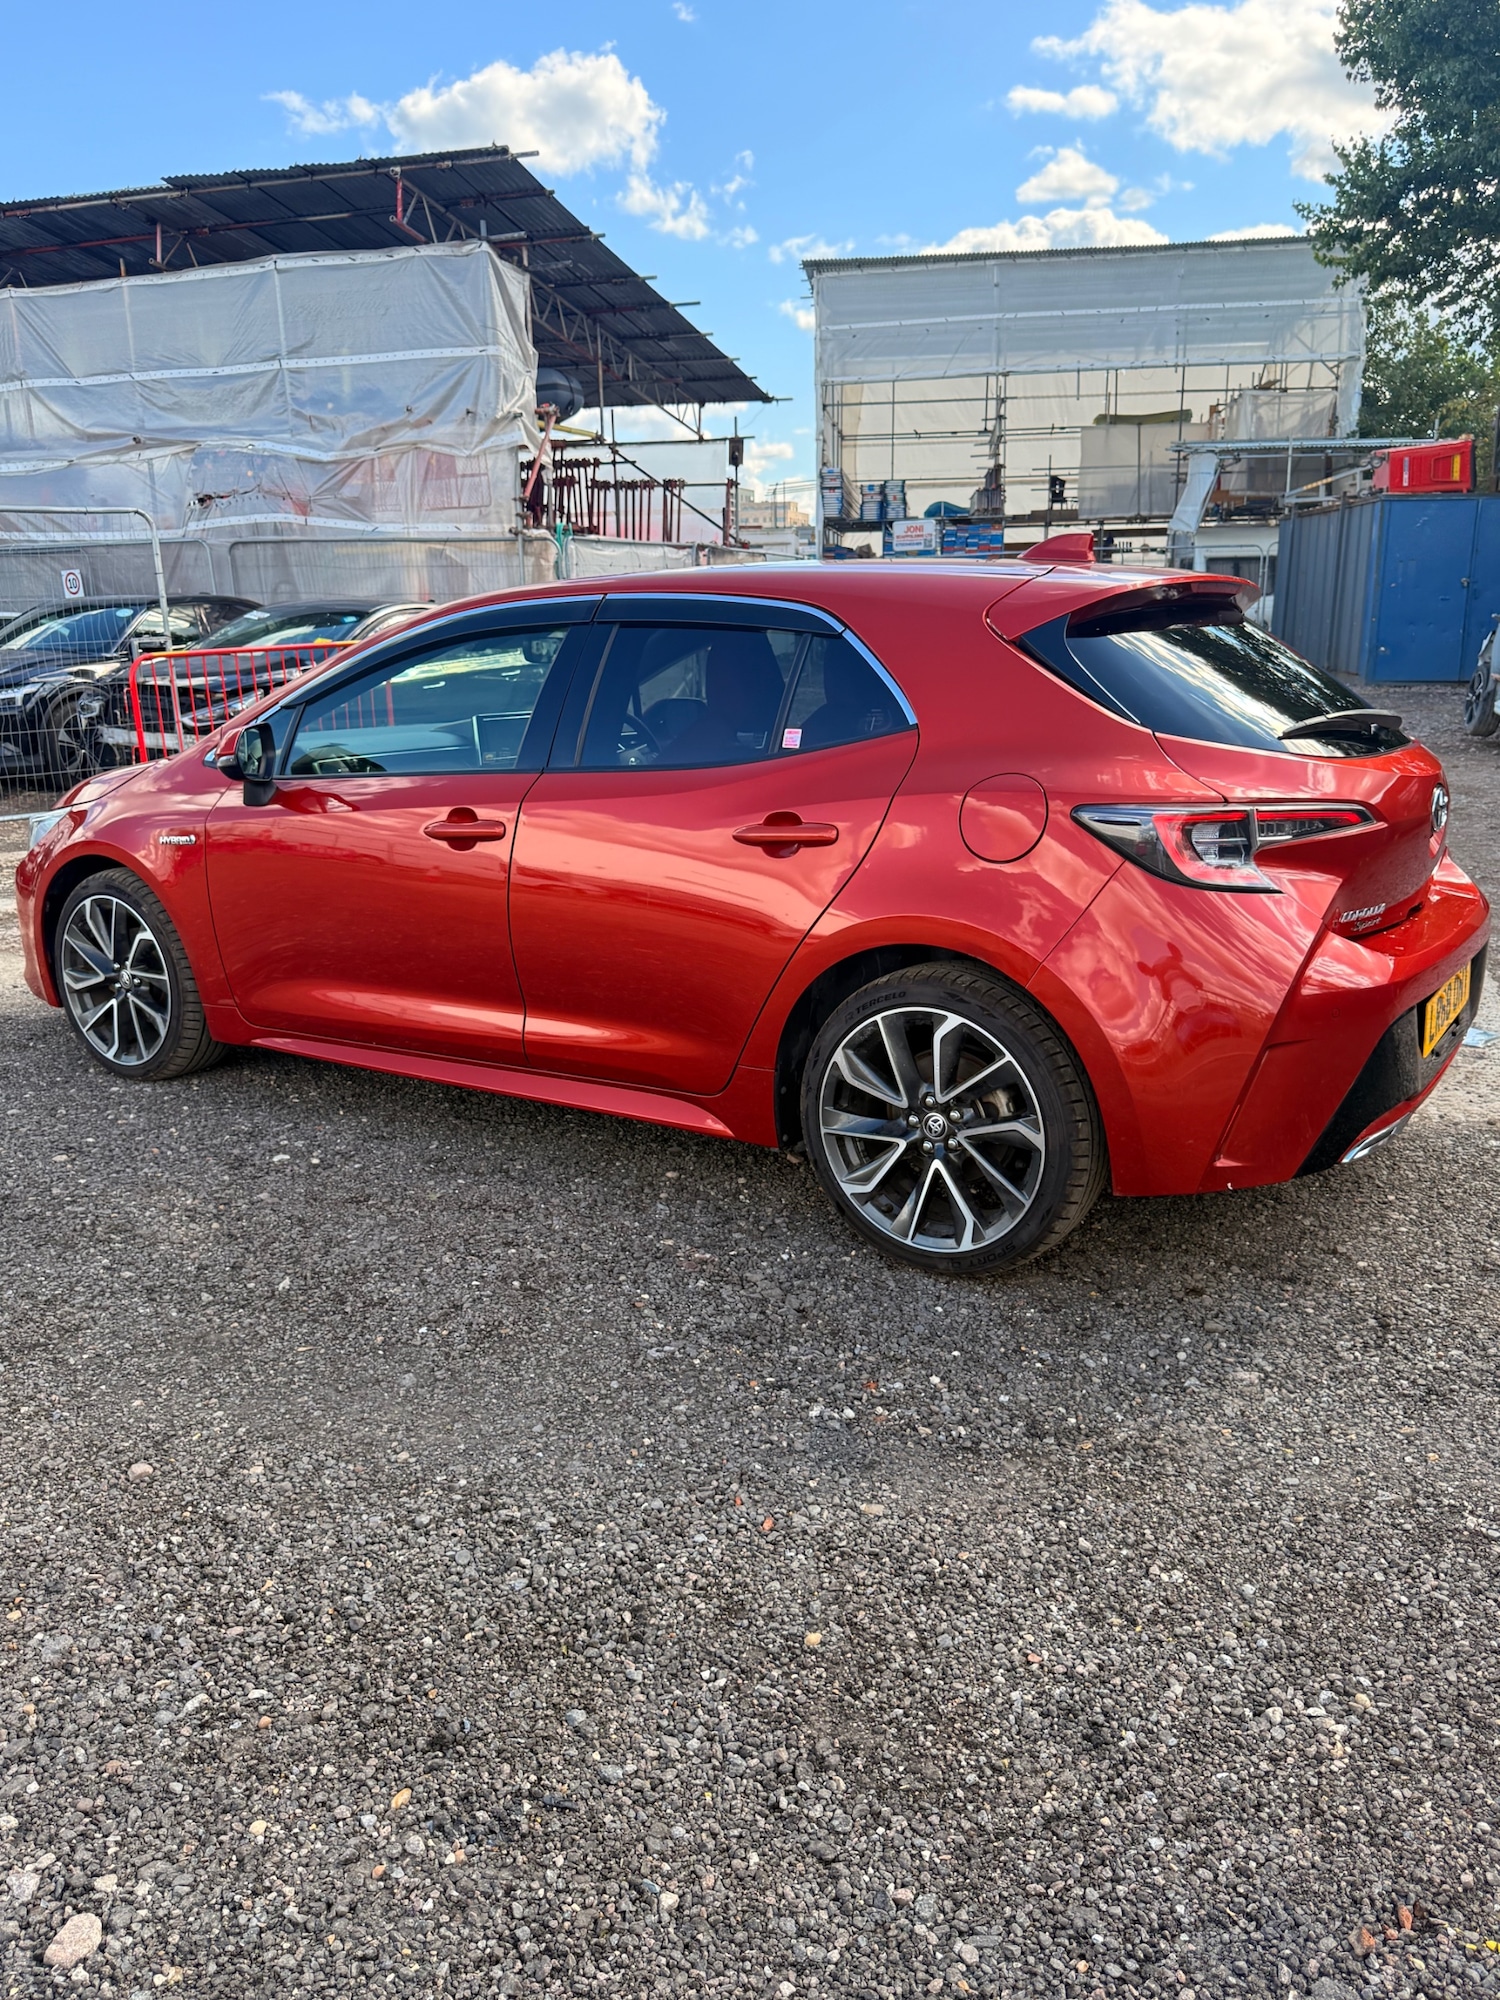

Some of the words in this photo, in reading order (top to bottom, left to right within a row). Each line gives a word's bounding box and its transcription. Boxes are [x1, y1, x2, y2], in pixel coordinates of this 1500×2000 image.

[904, 524, 924, 534] JONI
[68, 577, 78, 589] 10
[159, 835, 190, 845] HYBRID
[855, 991, 907, 1014] TERCELO
[968, 1241, 1016, 1268] SPORT
